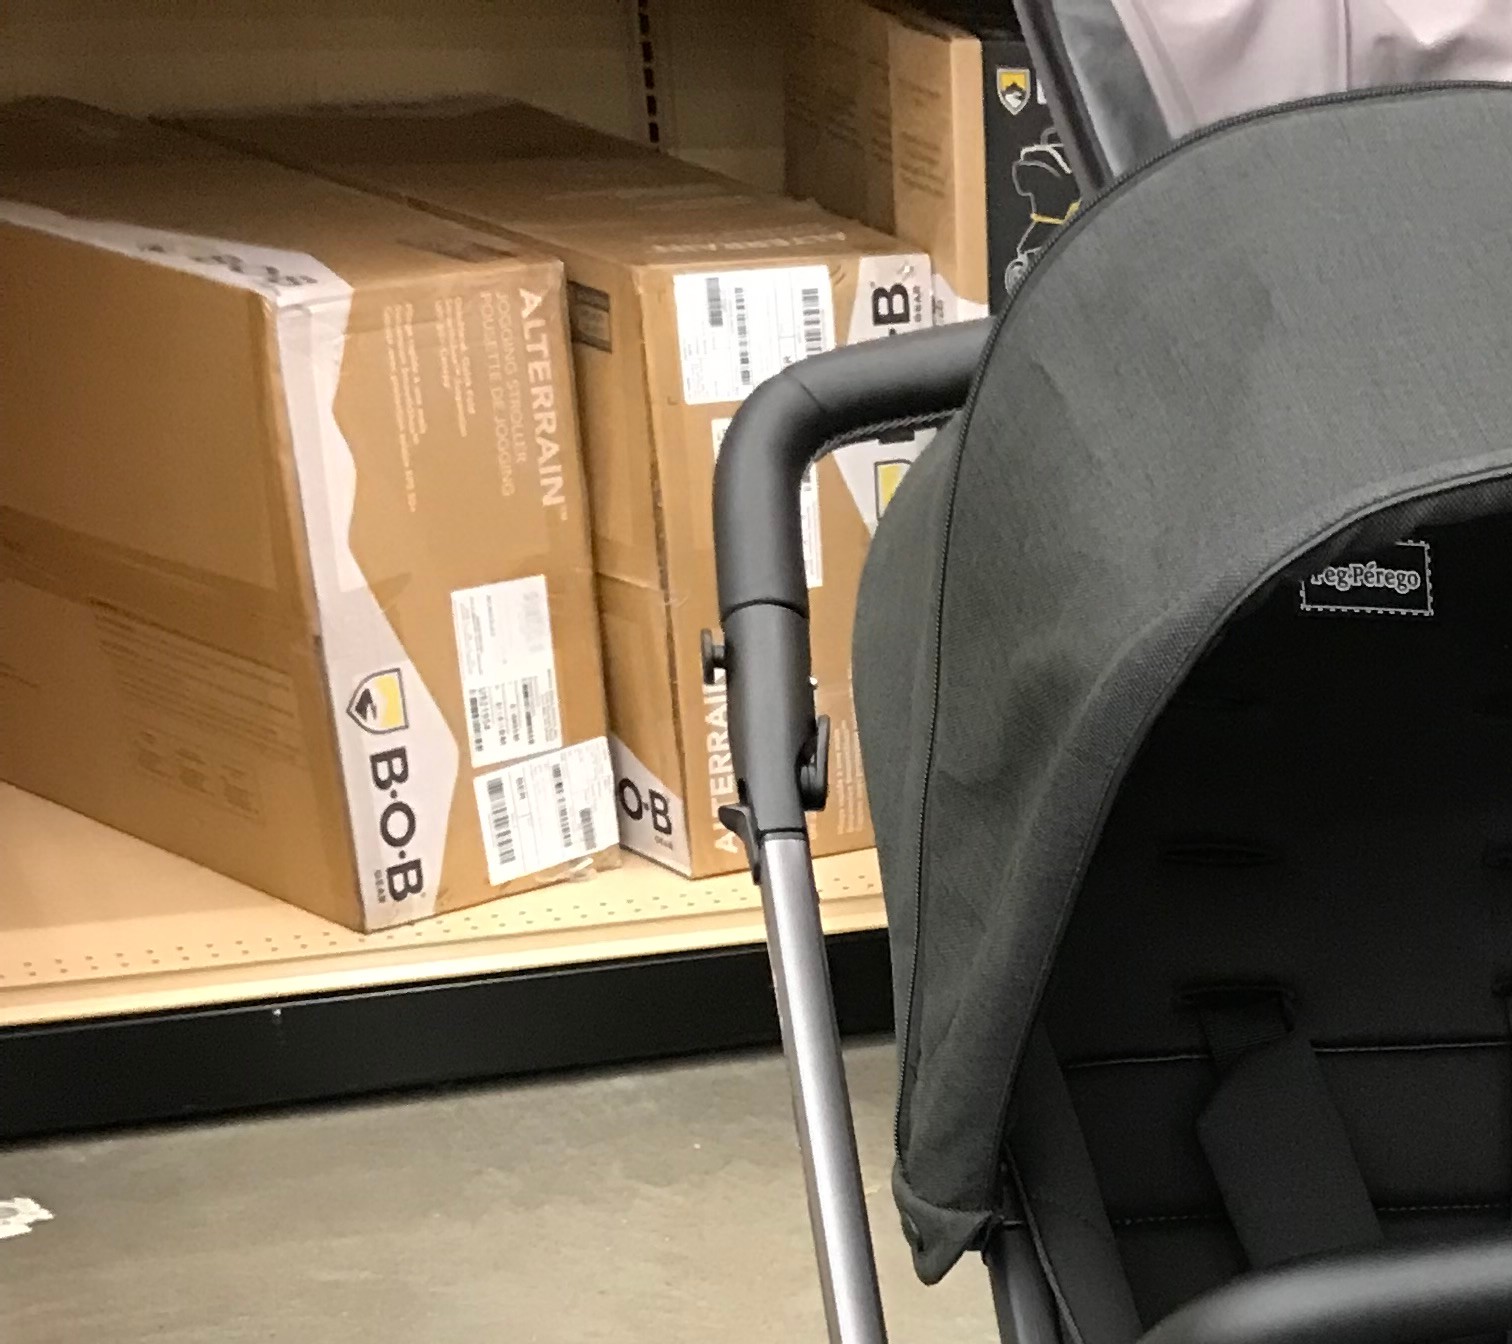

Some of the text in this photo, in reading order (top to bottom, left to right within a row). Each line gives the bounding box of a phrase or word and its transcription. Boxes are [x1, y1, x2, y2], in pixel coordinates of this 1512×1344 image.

[496, 291, 527, 463] JOGGING STROLLER
[494, 409, 515, 497] JOGGING
